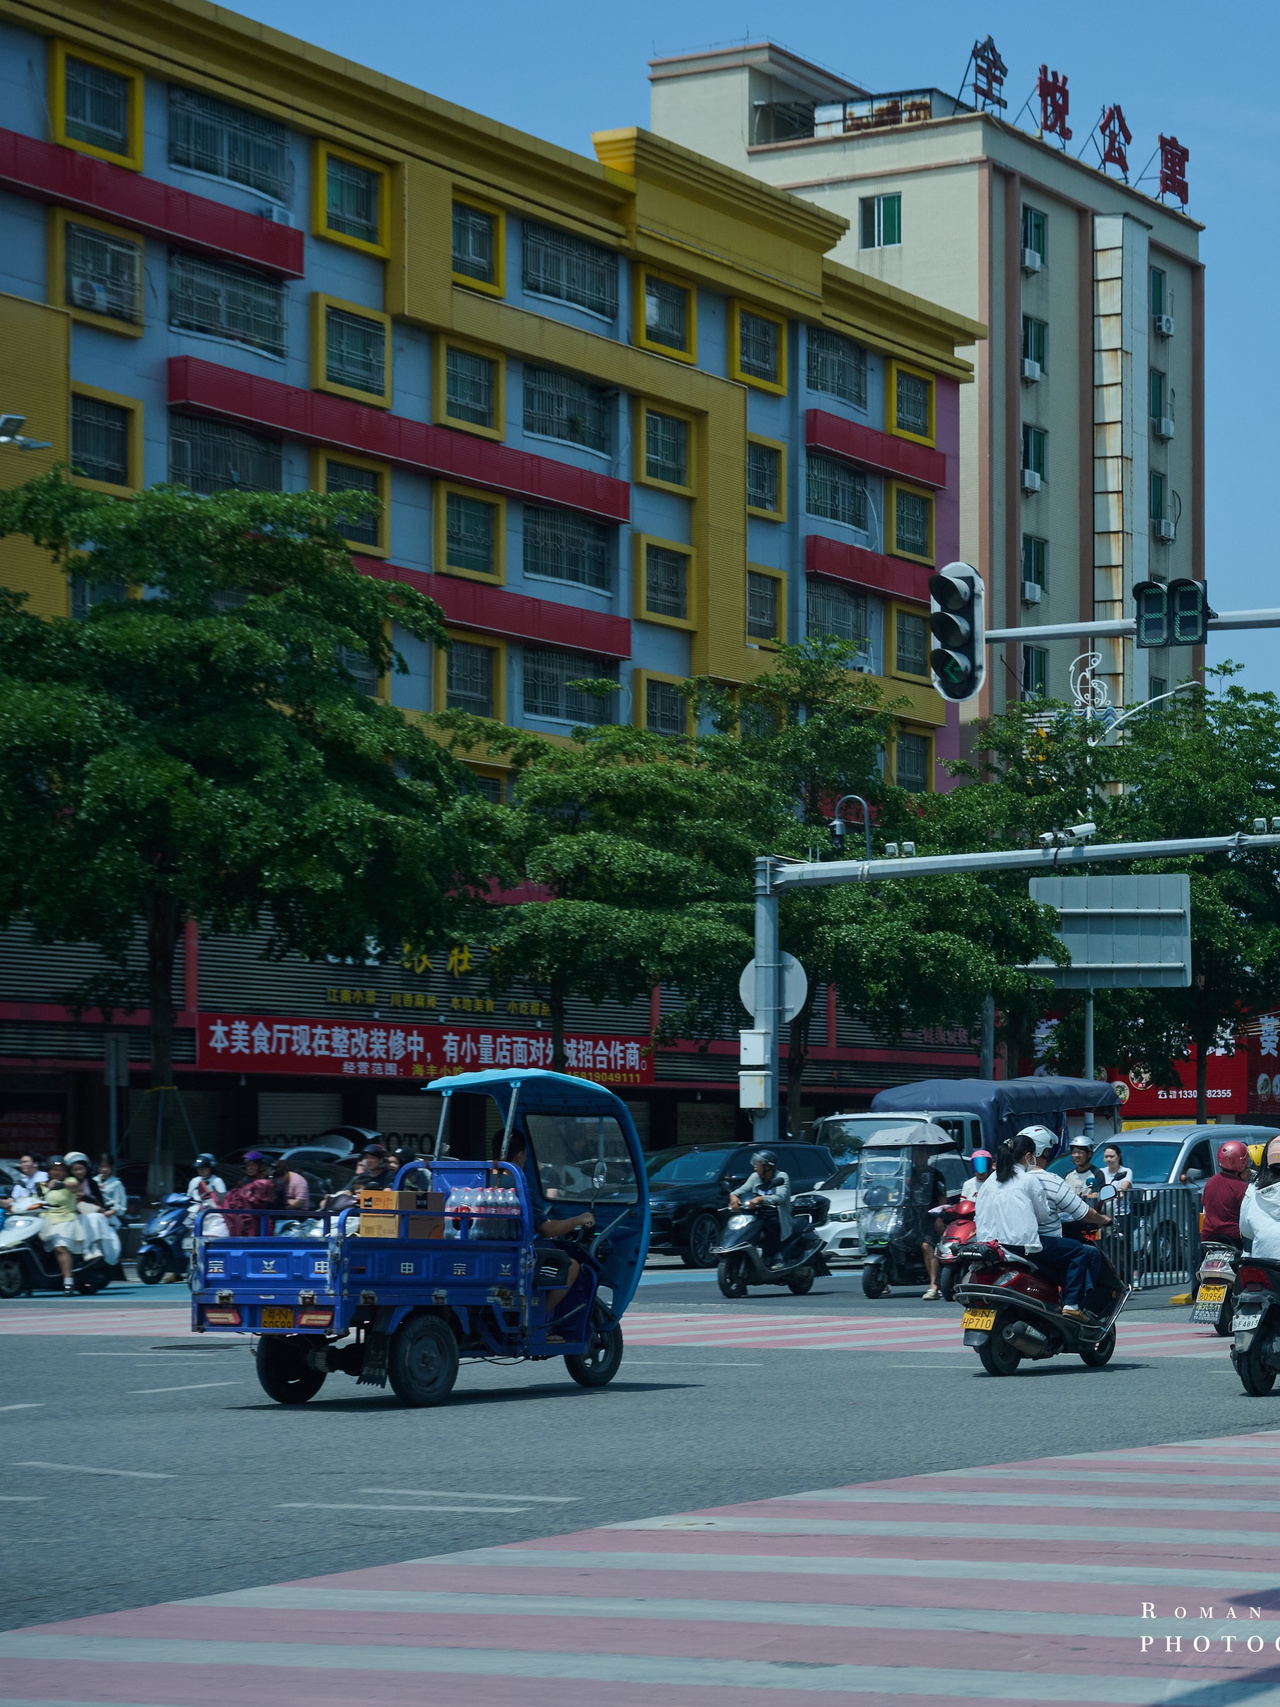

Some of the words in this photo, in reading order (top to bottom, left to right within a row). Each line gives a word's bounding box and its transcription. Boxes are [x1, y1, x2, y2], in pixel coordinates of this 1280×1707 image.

[1178, 1089, 1233, 1099] 133082355
[314, 1260, 330, 1274] 申
[400, 1262, 415, 1275] 申
[961, 1317, 992, 1329] HP710
